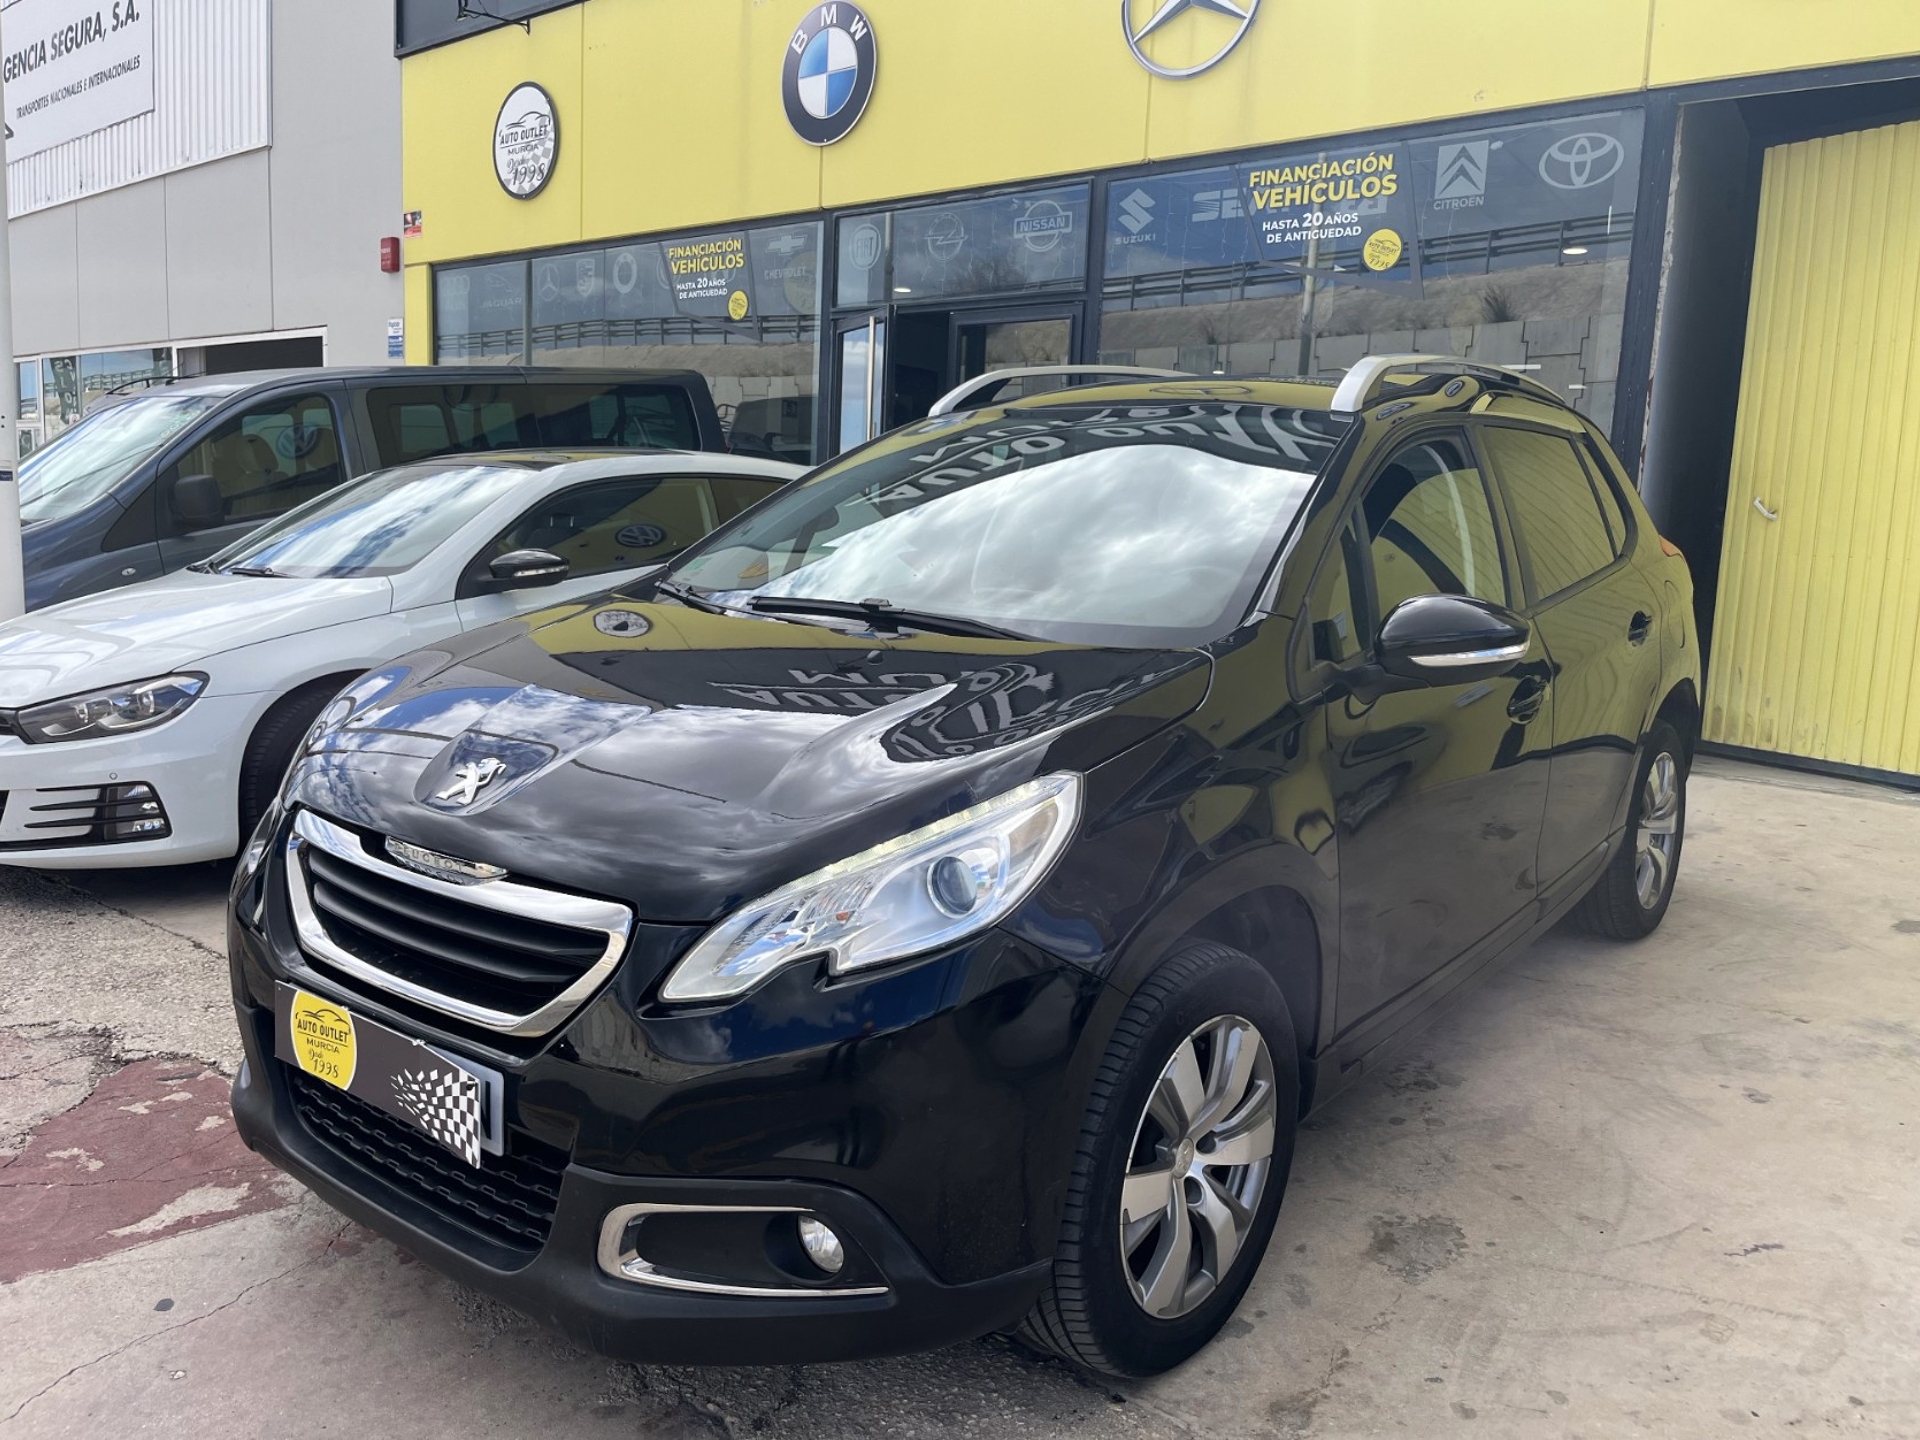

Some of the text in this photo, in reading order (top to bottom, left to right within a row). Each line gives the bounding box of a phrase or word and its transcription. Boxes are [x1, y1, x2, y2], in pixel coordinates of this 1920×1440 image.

[50, 11, 107, 60] SEGURA,
[111, 0, 140, 32] S.A.
[791, 4, 868, 54] BMW
[16, 54, 140, 119] TRANSPORTES NACIONALES E INTERNACIONALES
[500, 125, 548, 146] AUTO OUTLET
[507, 144, 540, 156] MURCIA
[512, 162, 546, 186] 1998
[1249, 152, 1394, 188] FINANCIACIÓN
[1253, 173, 1398, 210] VEHÍCULOS
[1019, 216, 1066, 232] NISSAN
[1262, 212, 1359, 232] HASTA 20 AÑOS
[1115, 233, 1156, 245] SUZUKI
[1266, 226, 1362, 244] DE ANTIGUEDAD
[668, 238, 742, 259] FINANCIACIÓN
[671, 253, 745, 275] VEHÍCULOS
[764, 266, 806, 279] CHEVROLET
[676, 277, 726, 291] HASTA 20 AÑOS
[679, 291, 688, 299] DE
[297, 1019, 349, 1043] AUTO OUTLET
[306, 1037, 340, 1055] MURCIA
[313, 1058, 340, 1079] 1998
